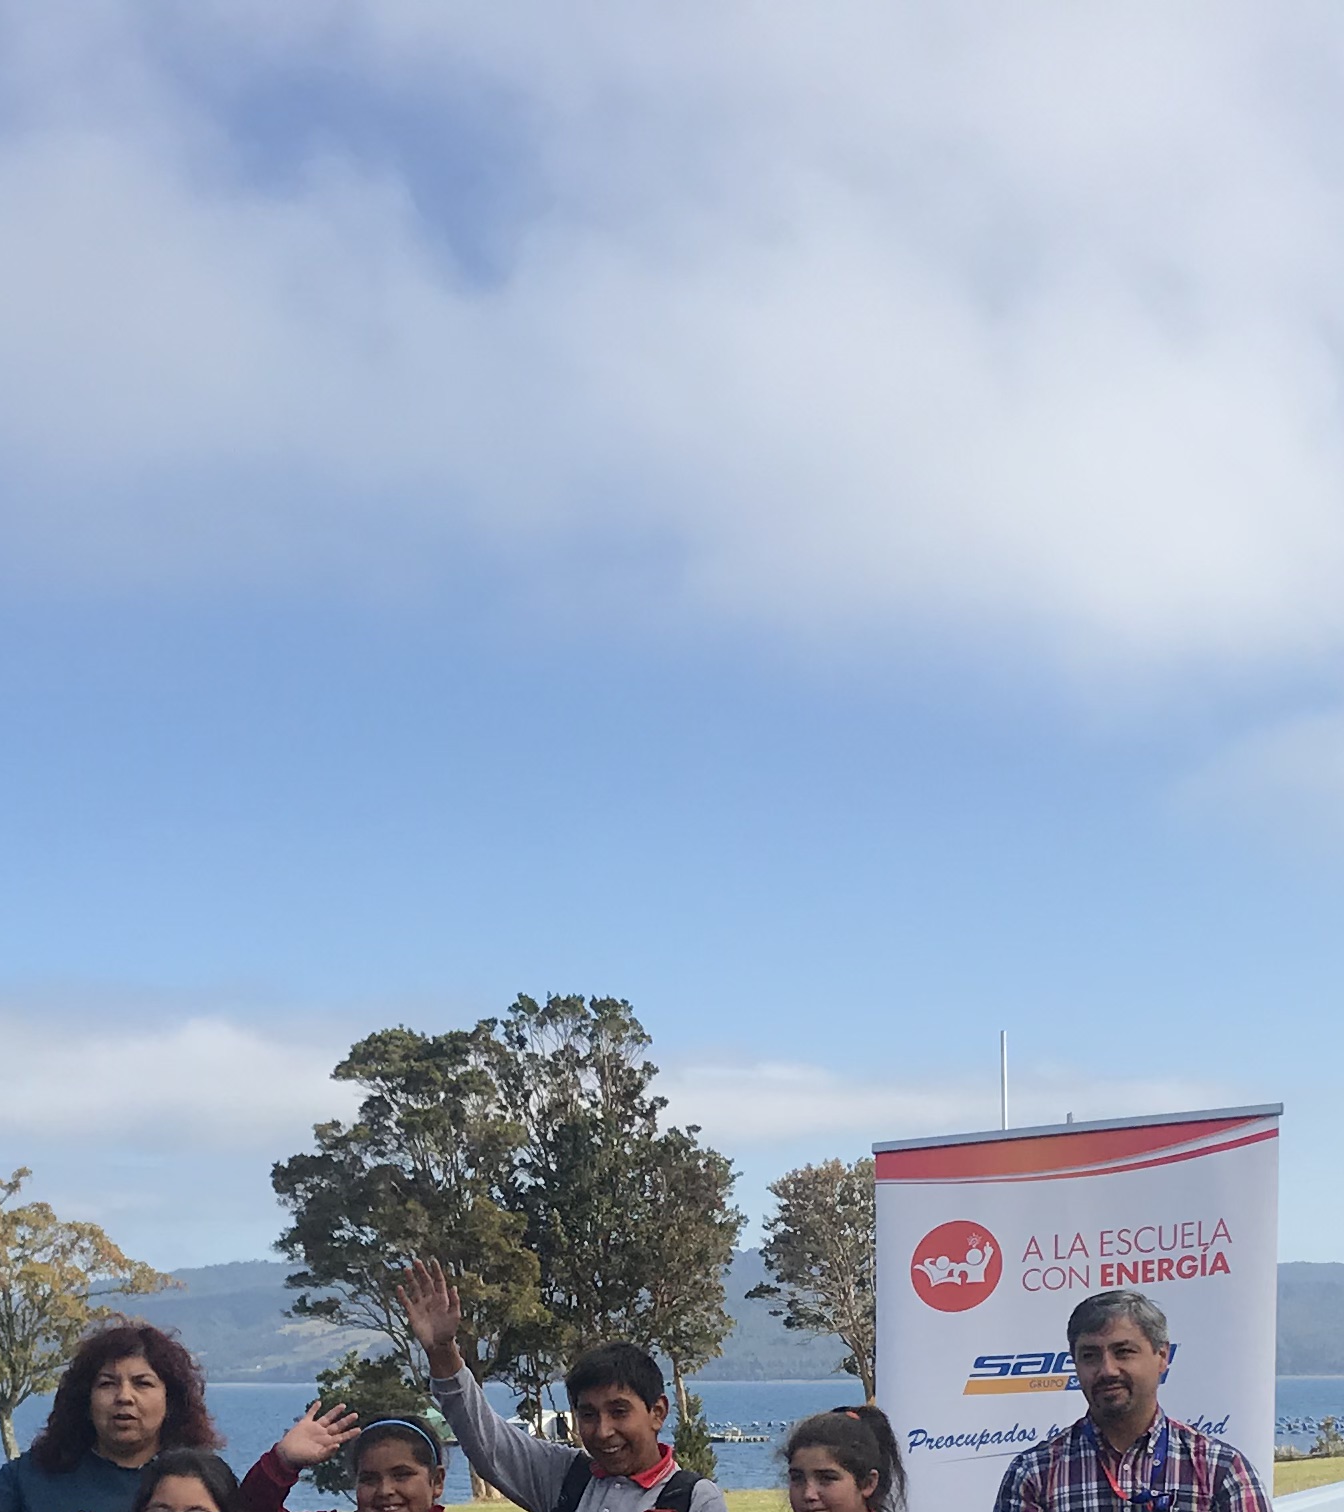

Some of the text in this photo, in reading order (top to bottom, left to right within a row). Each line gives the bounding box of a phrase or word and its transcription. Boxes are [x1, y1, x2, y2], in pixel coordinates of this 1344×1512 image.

[1021, 1217, 1233, 1263] A LA ESCUELA
[1022, 1245, 1232, 1292] CON ENERGÍA
[1029, 1378, 1064, 1389] GRUPO
[907, 1422, 1038, 1454] Preocupados
